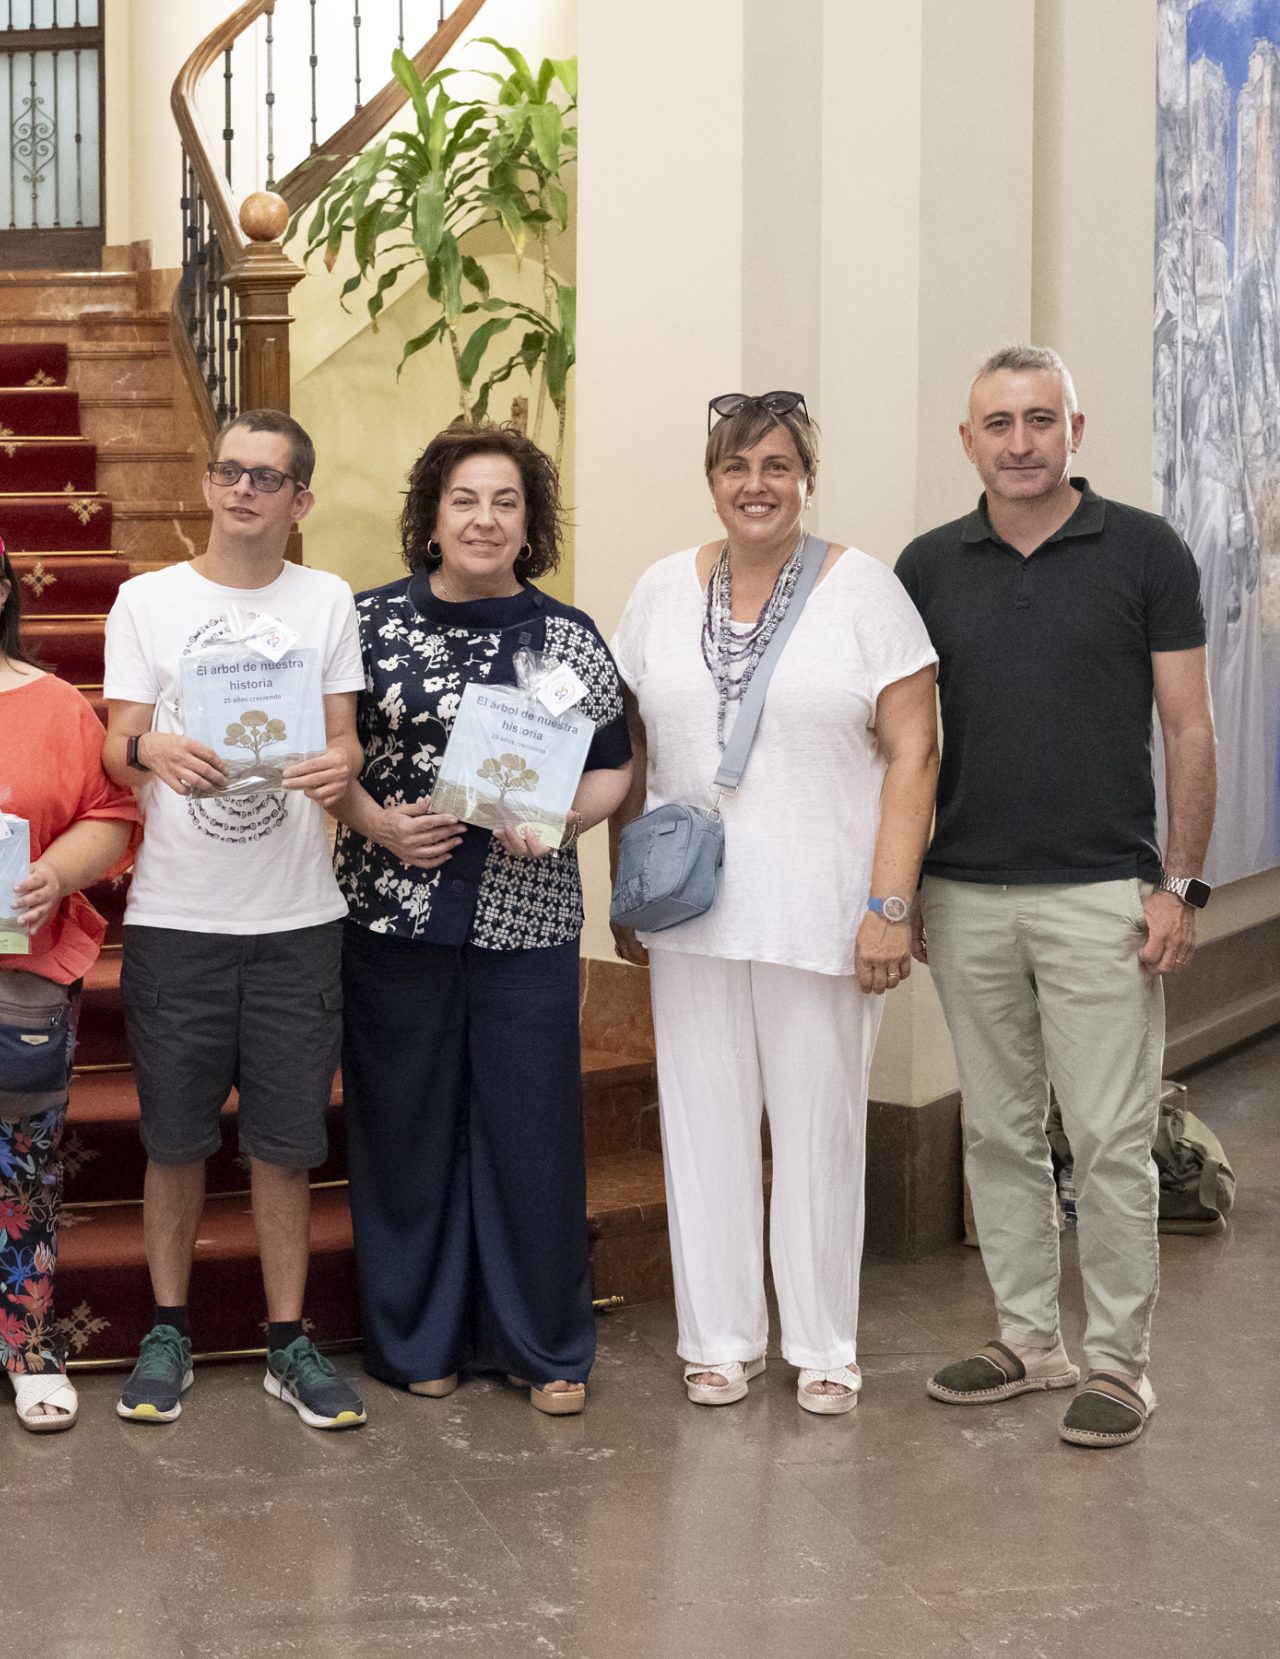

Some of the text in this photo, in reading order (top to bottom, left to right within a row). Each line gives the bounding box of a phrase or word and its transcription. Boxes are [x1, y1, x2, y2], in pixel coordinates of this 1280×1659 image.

[196, 659, 304, 676] El árbol de nuestra
[229, 679, 273, 690] historia
[476, 695, 579, 734] El árbol de nuestra
